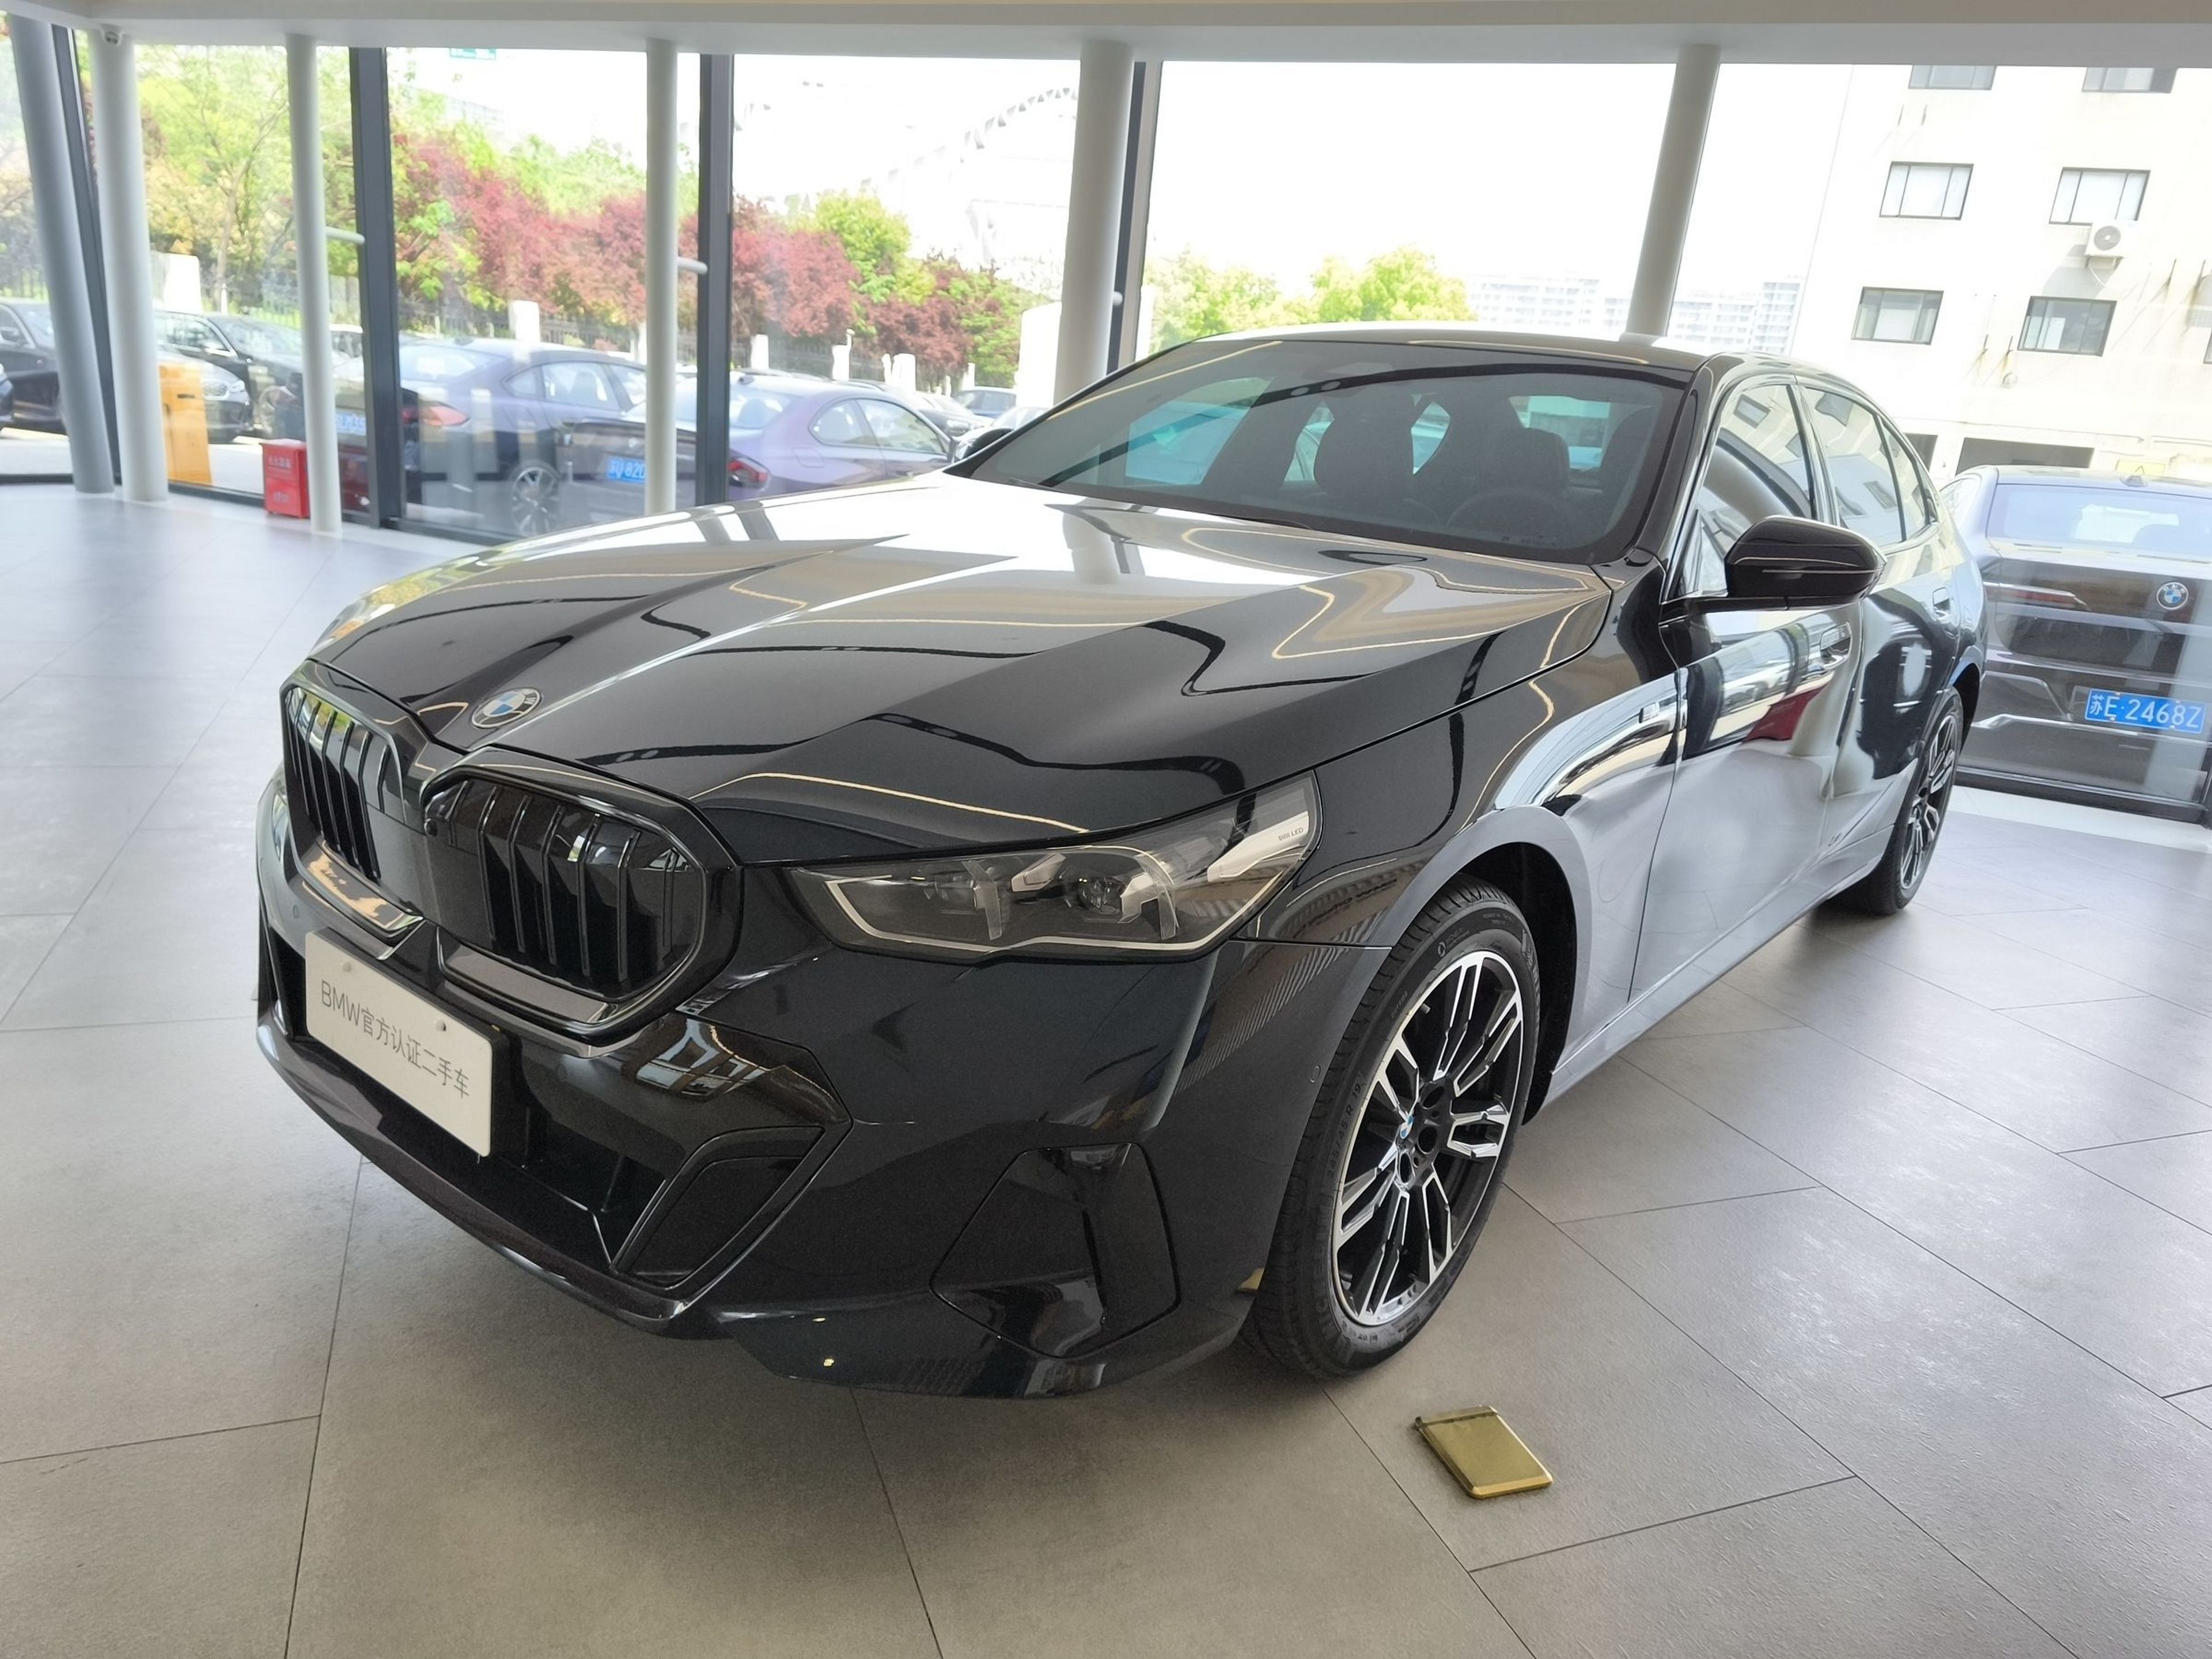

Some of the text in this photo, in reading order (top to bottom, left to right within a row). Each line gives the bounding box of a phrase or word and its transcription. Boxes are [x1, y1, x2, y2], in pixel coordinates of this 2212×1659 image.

[1278, 827, 1304, 841] BMW LED
[321, 980, 469, 1099] BMW官方认证二手车
[1328, 1084, 1361, 1179] 245/45 R 19
